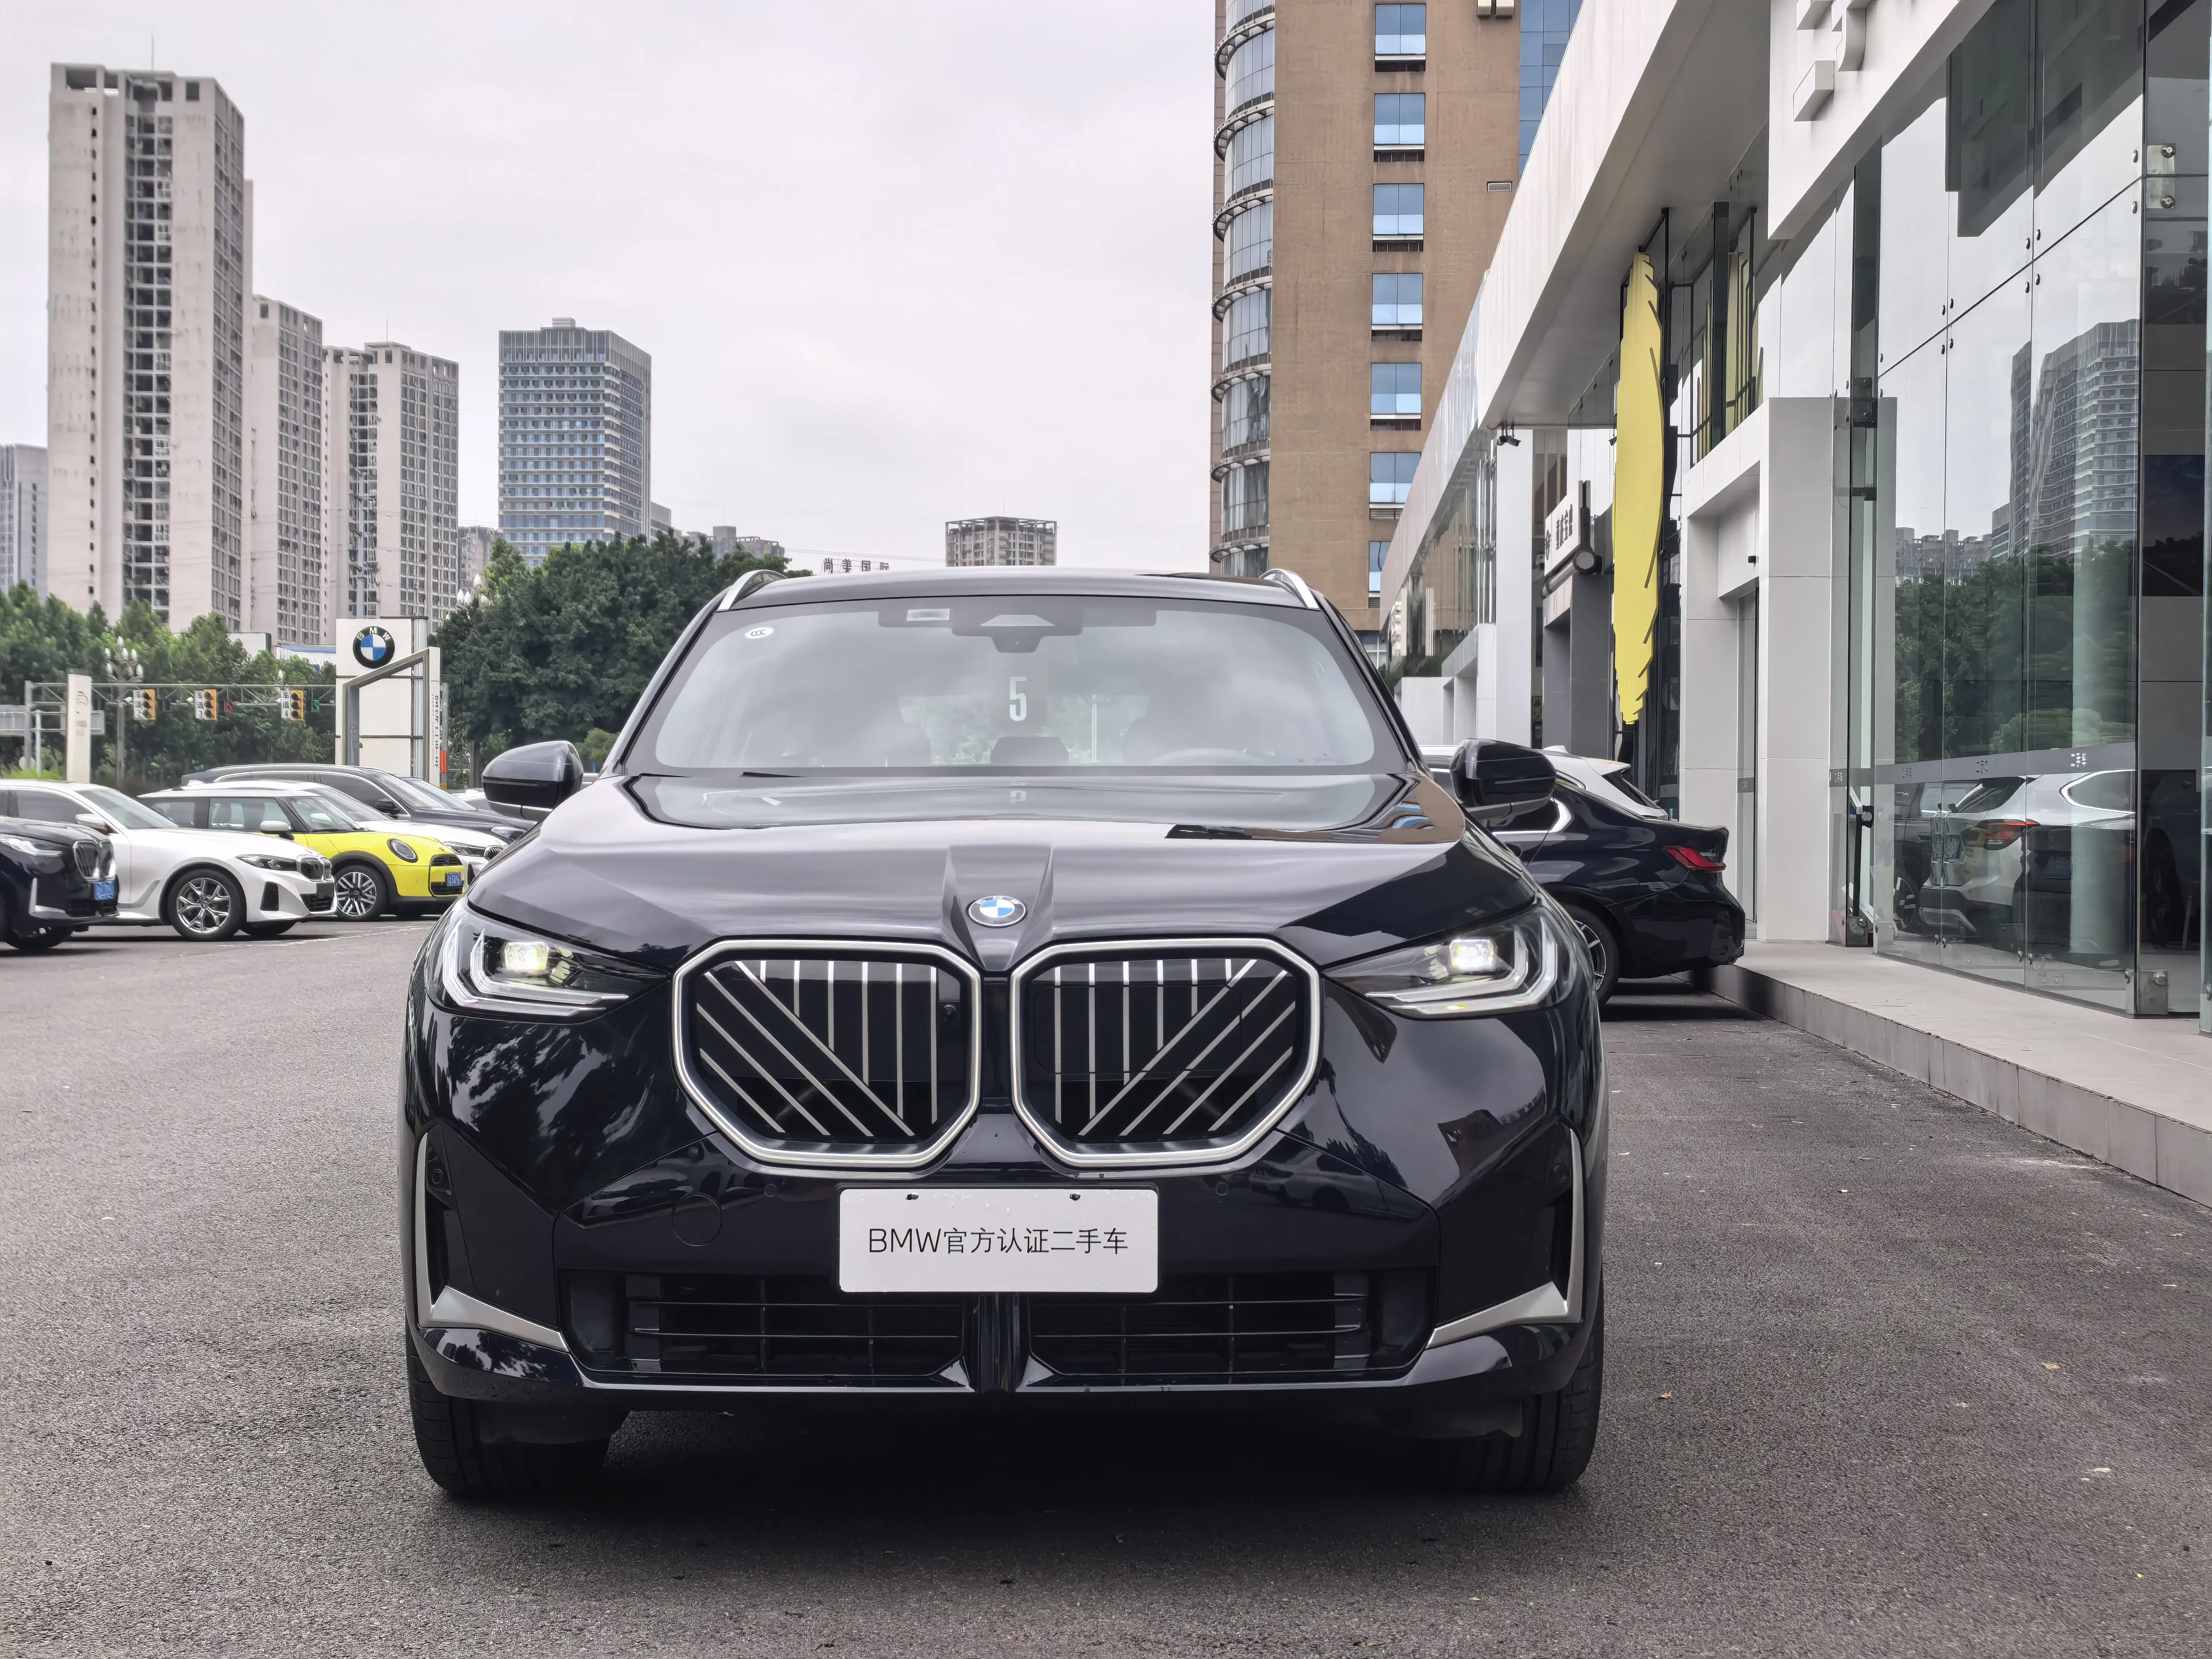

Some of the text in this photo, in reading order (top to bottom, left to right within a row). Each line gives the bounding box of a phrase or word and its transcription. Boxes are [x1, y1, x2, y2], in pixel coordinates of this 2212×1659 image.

[356, 627, 391, 641] BMW
[1010, 676, 1027, 721] 5
[869, 1227, 1128, 1255] BMW官方认证二手车
